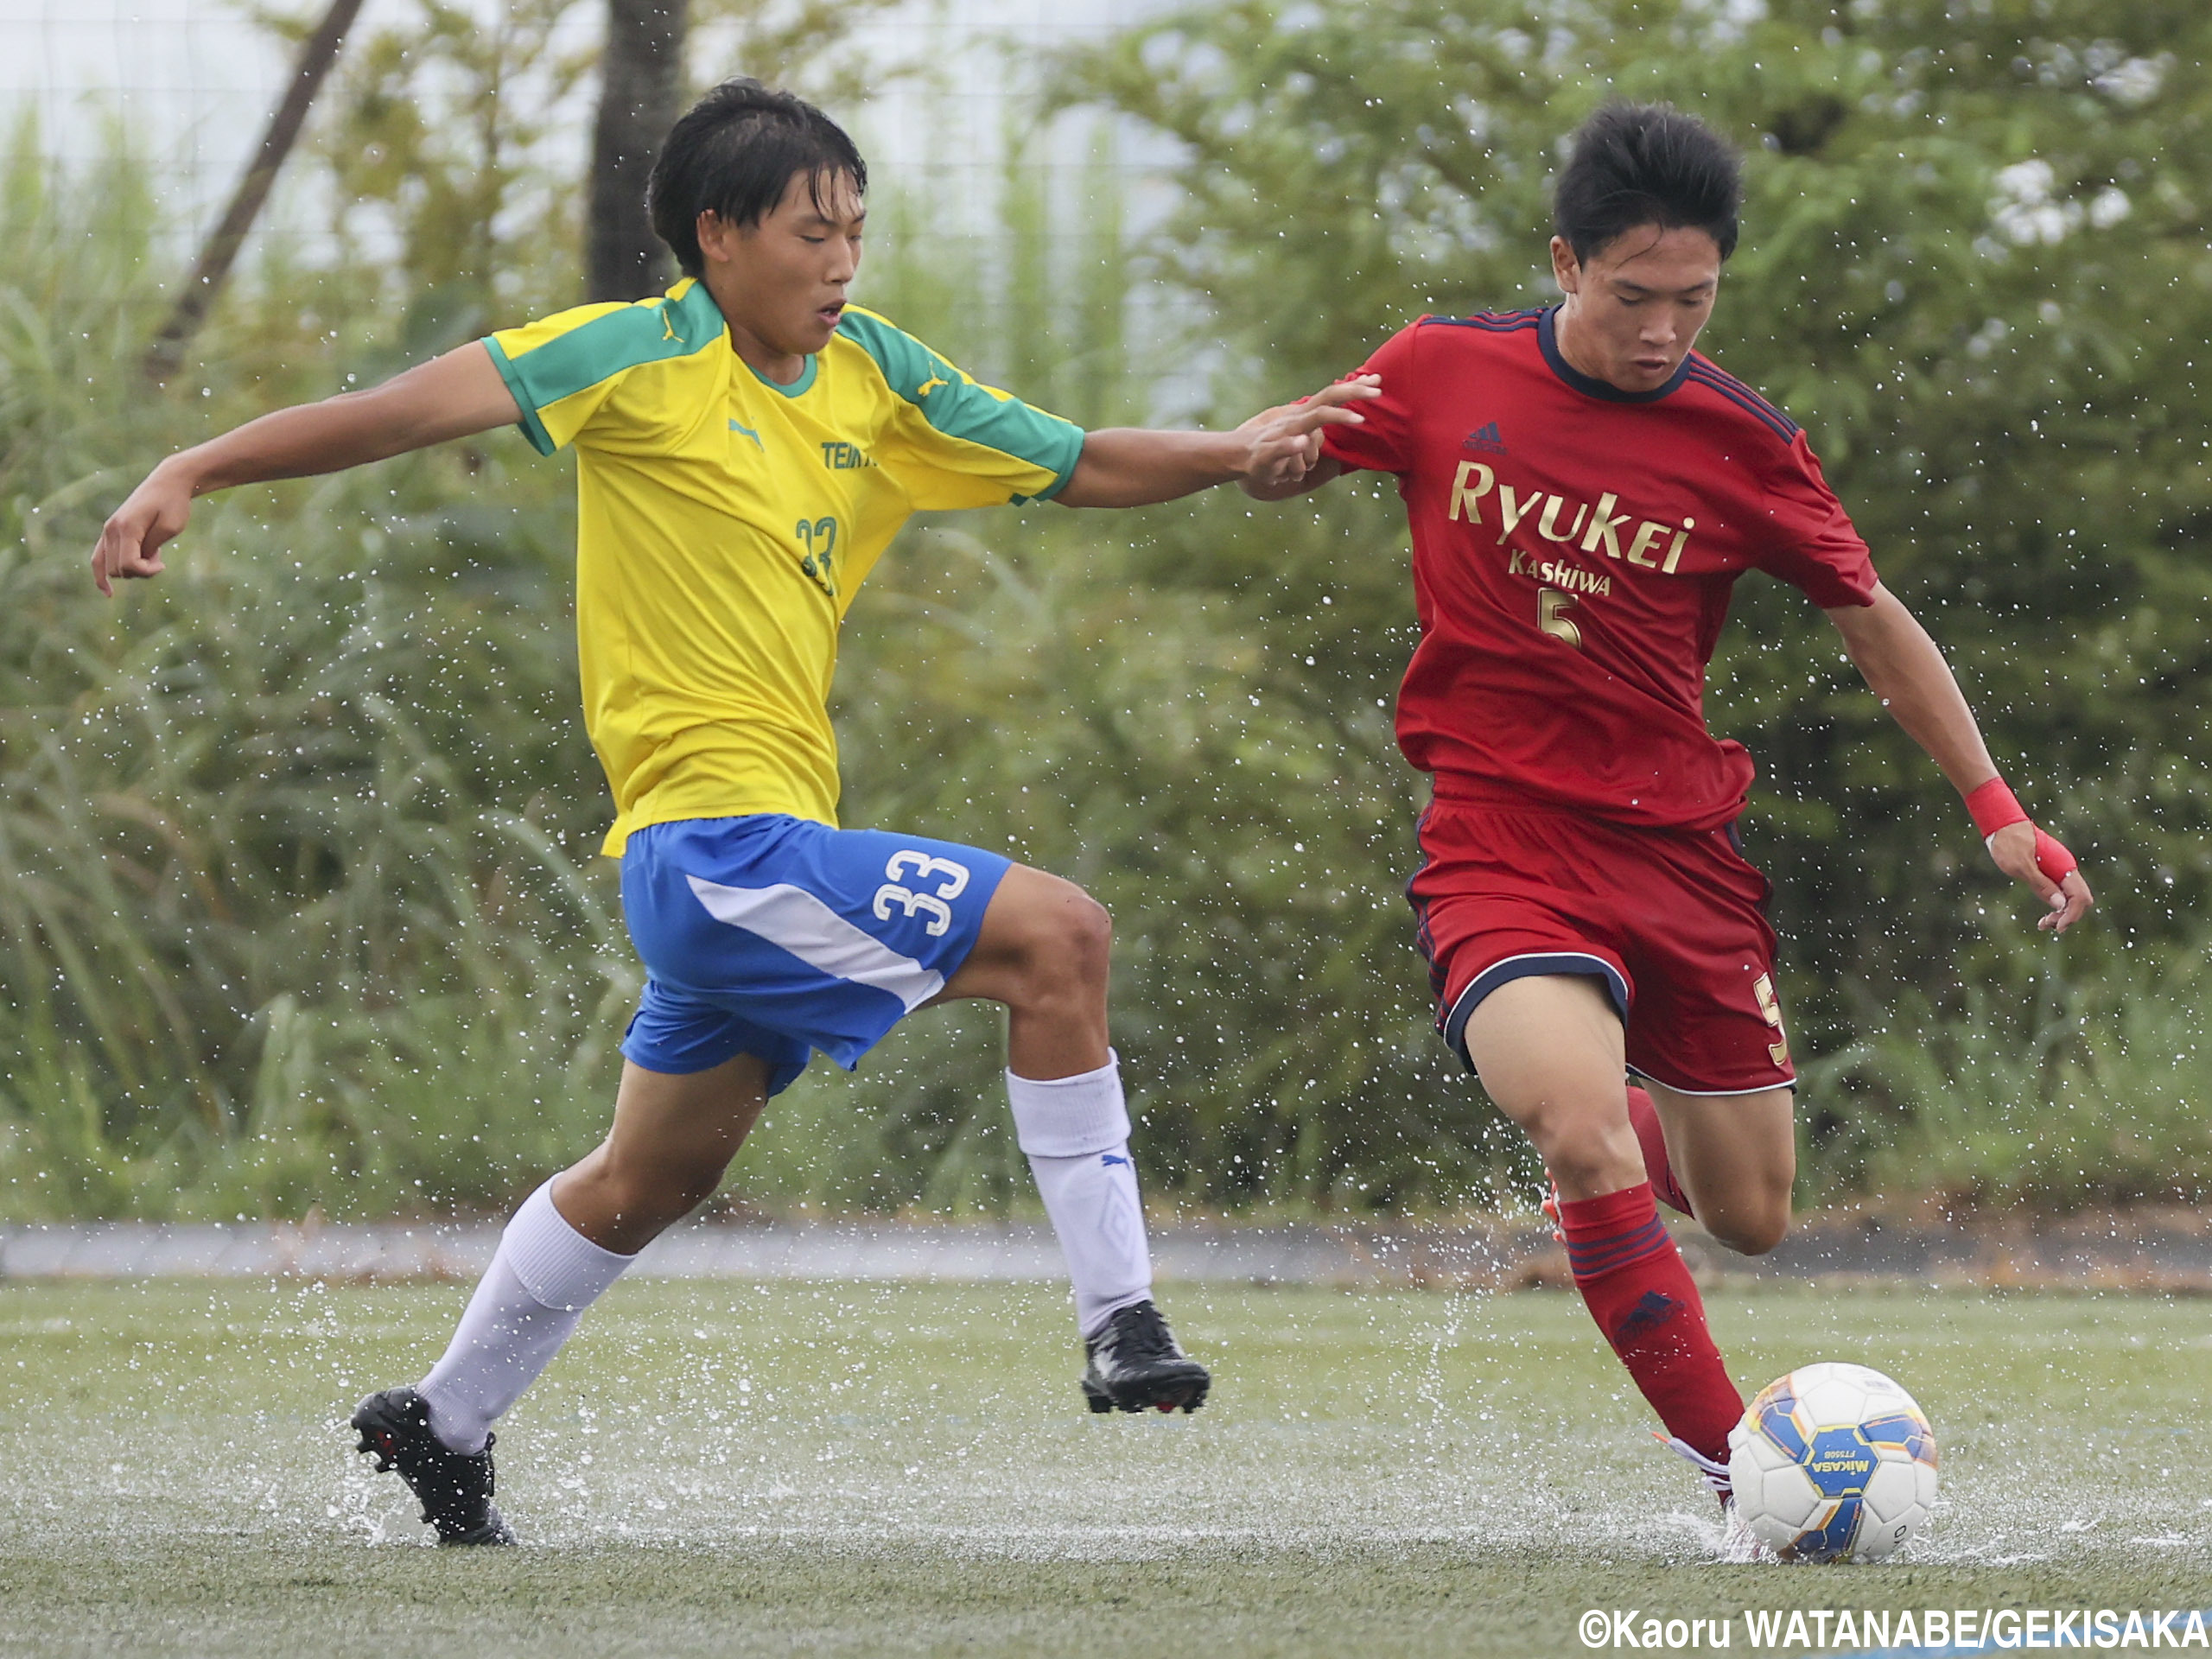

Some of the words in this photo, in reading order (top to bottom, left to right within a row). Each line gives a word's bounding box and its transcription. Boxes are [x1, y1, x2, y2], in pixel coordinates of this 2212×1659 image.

[1508, 549, 1611, 596] KASHiWA
[1537, 587, 1581, 650] 5
[873, 849, 969, 937] 33
[1812, 1460, 1869, 1476] MiKASA
